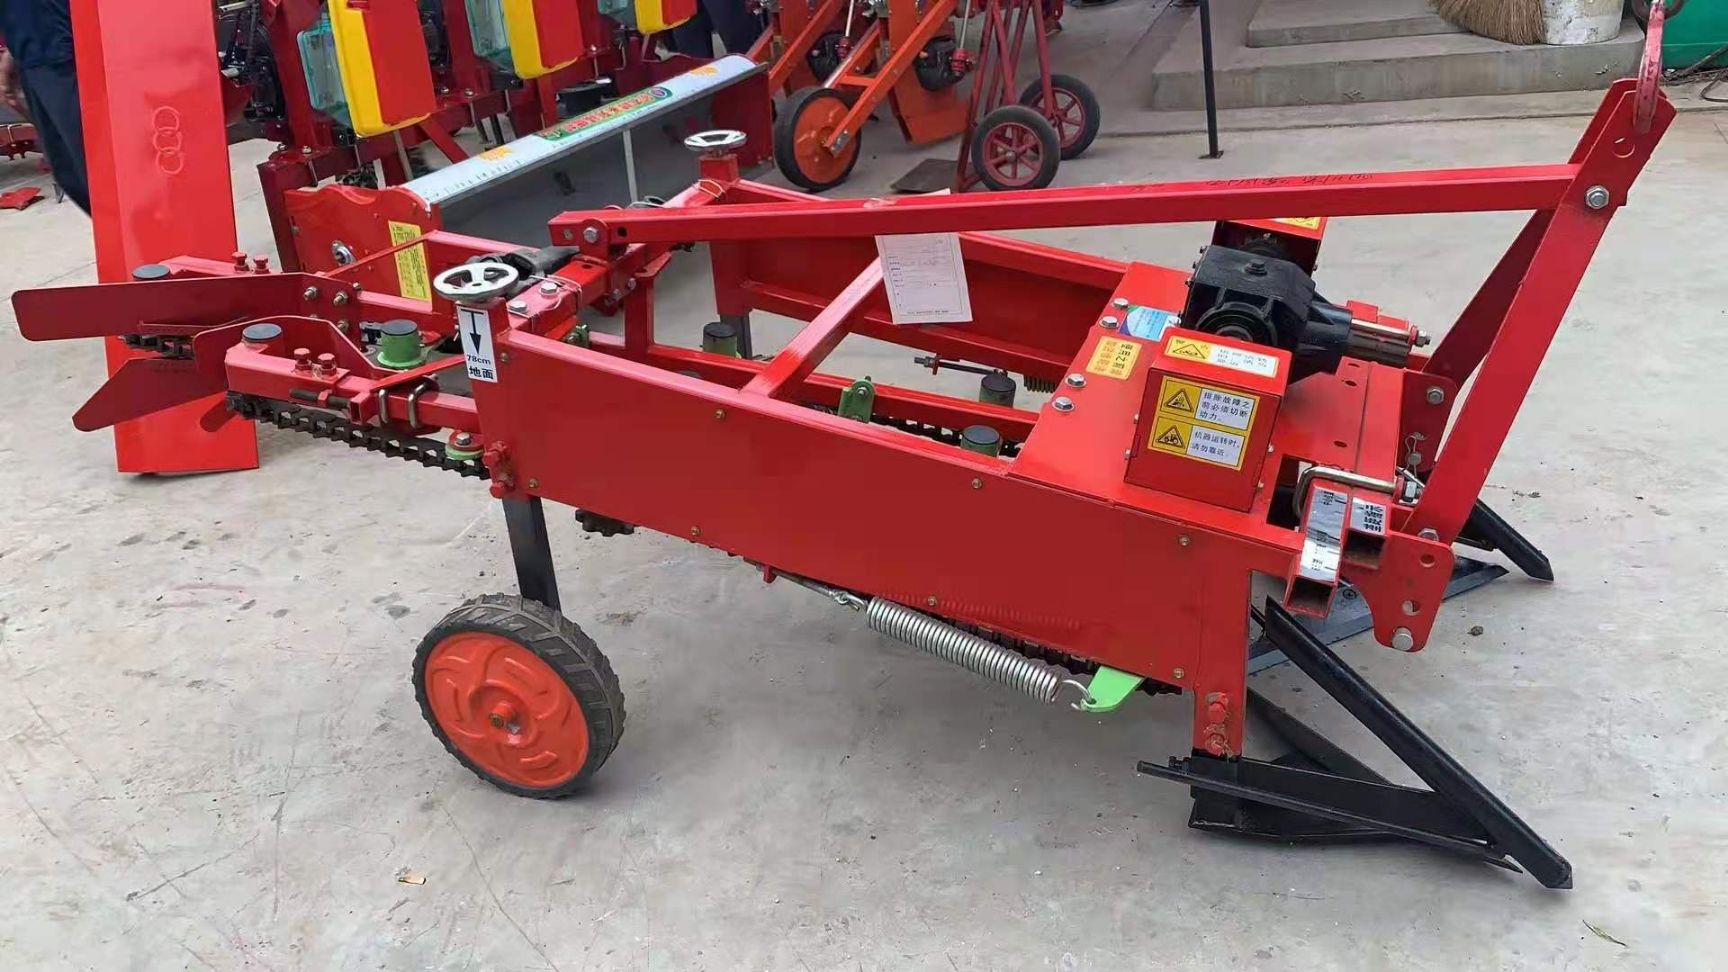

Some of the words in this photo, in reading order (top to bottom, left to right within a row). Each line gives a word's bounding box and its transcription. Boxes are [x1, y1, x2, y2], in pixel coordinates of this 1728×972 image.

[466, 354, 491, 365] 78cm
[469, 366, 493, 380] 地面
[1204, 392, 1249, 409] 排除故障之
